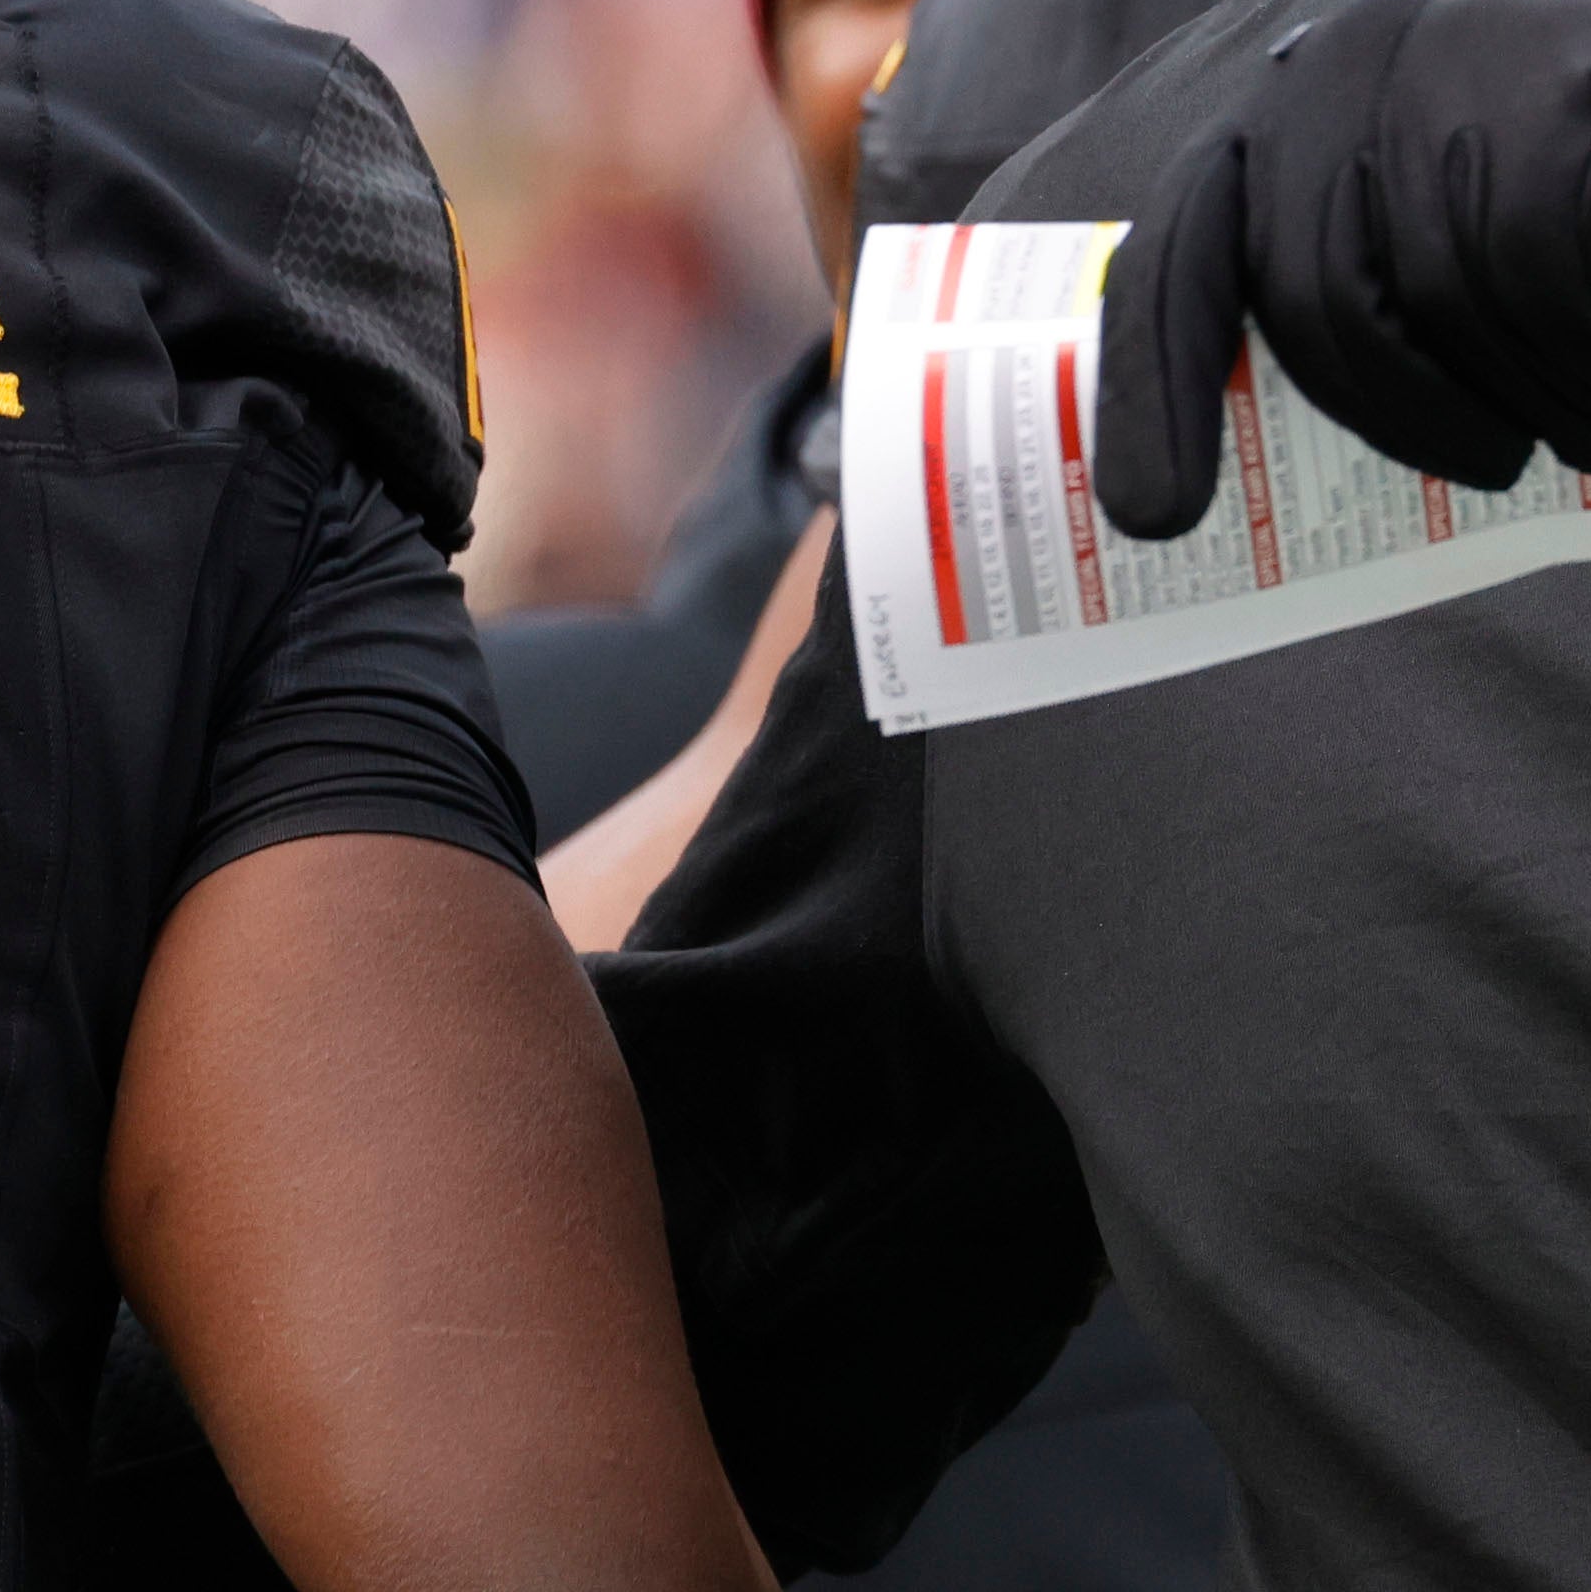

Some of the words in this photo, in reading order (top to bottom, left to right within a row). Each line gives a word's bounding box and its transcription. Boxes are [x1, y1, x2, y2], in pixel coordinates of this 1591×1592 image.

[1066, 491, 1094, 552] TEAMS
[1244, 465, 1271, 520] TEAMS
[1255, 524, 1281, 585] SPECIAL
[1073, 558, 1106, 624] SPECIAL
